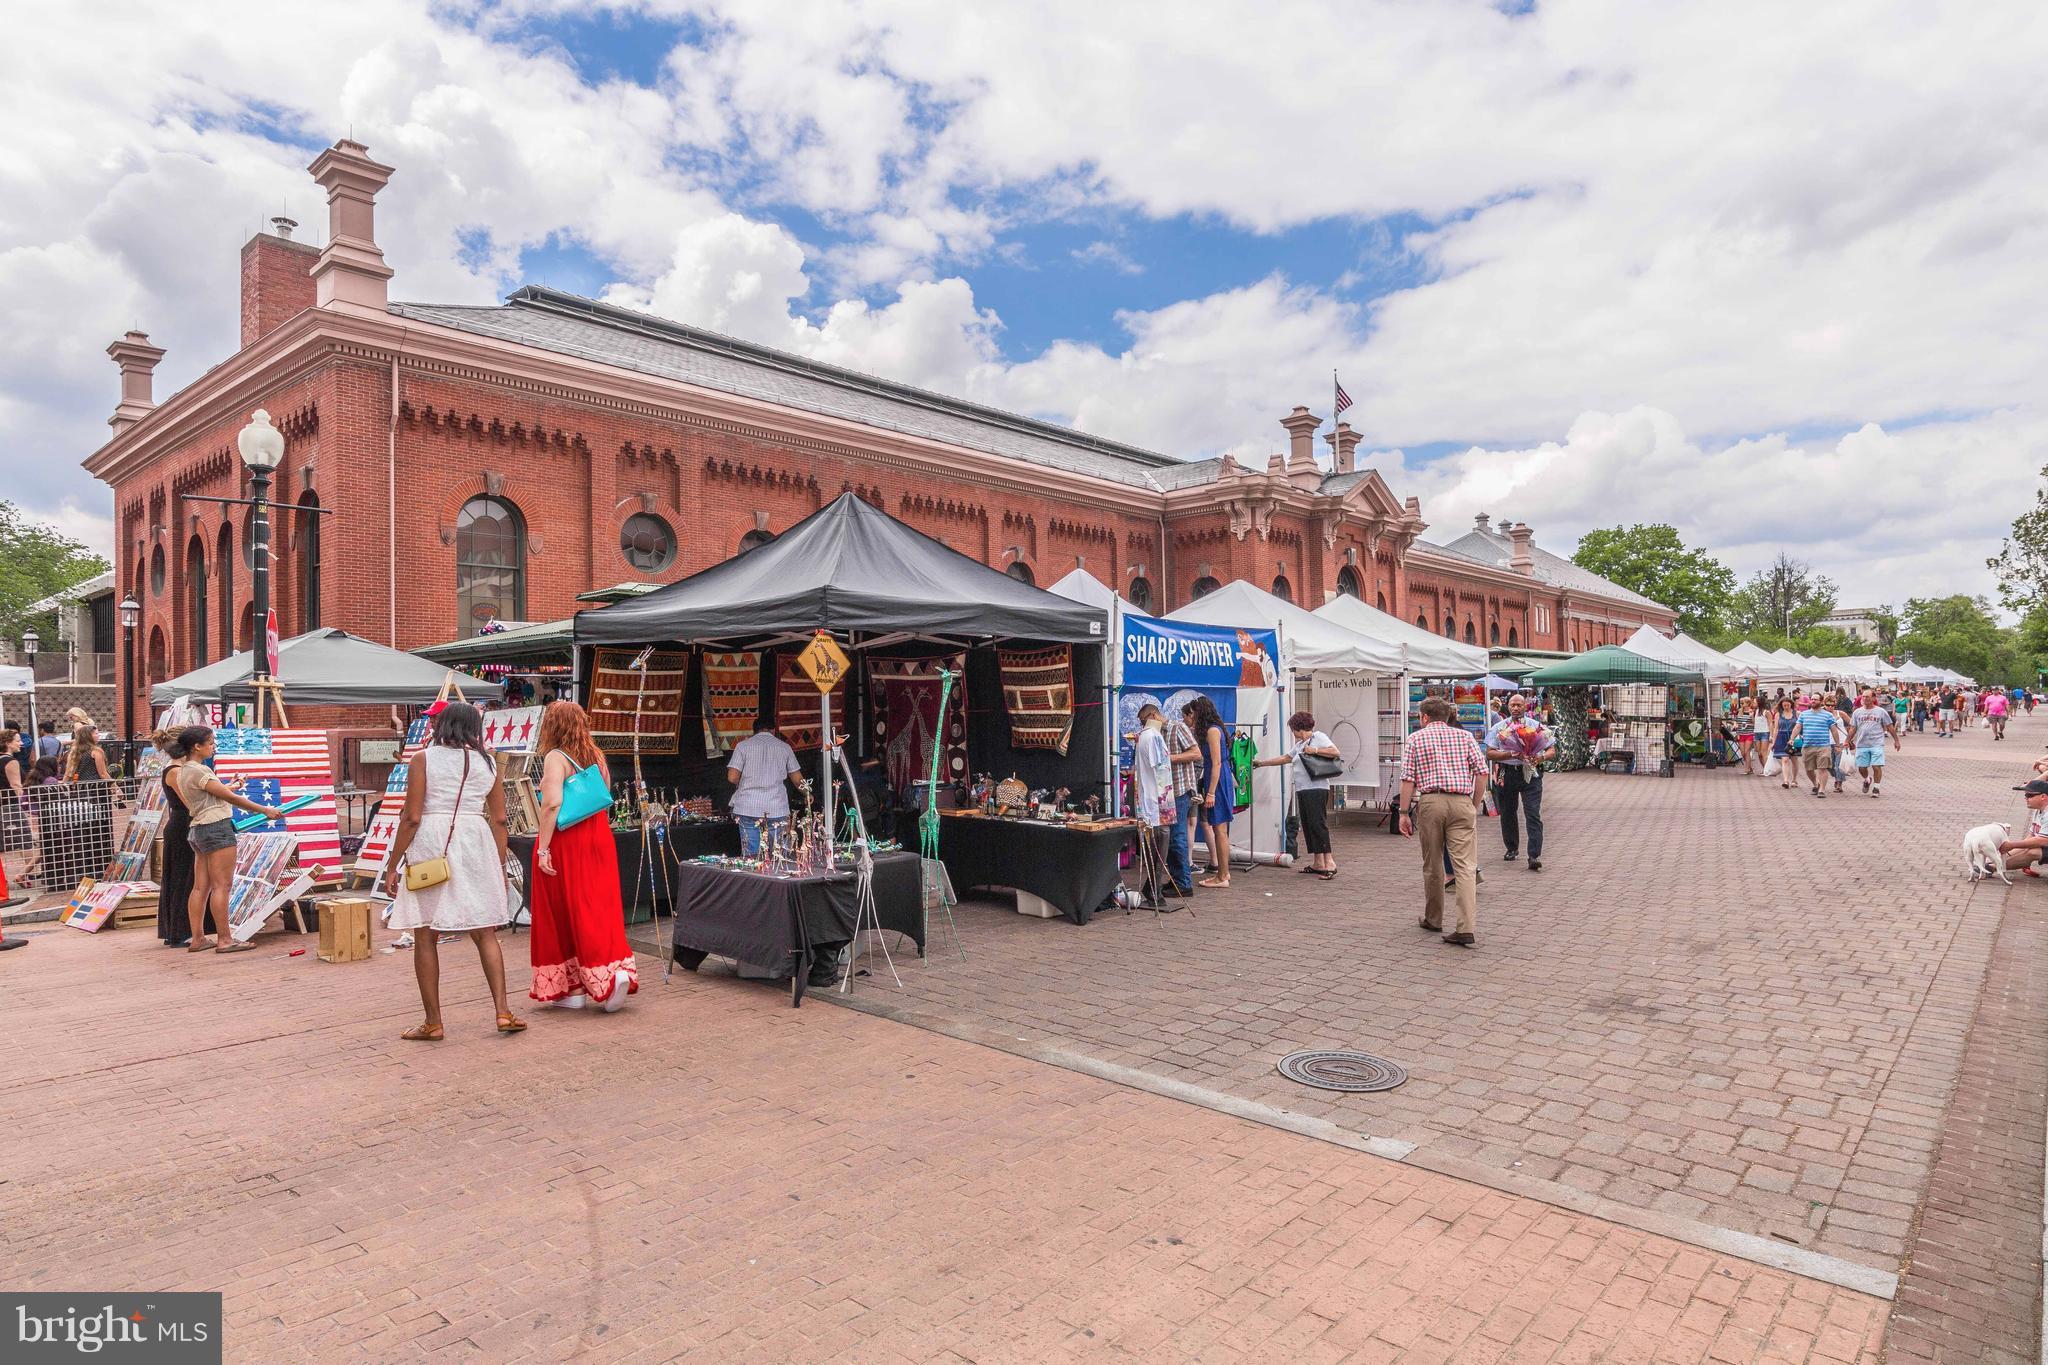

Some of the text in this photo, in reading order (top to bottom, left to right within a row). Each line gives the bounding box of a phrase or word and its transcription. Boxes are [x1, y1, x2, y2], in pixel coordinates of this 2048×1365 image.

[1127, 634, 1234, 667] SHARP SHIRTER
[1318, 677, 1373, 689] Turtle's Webb
